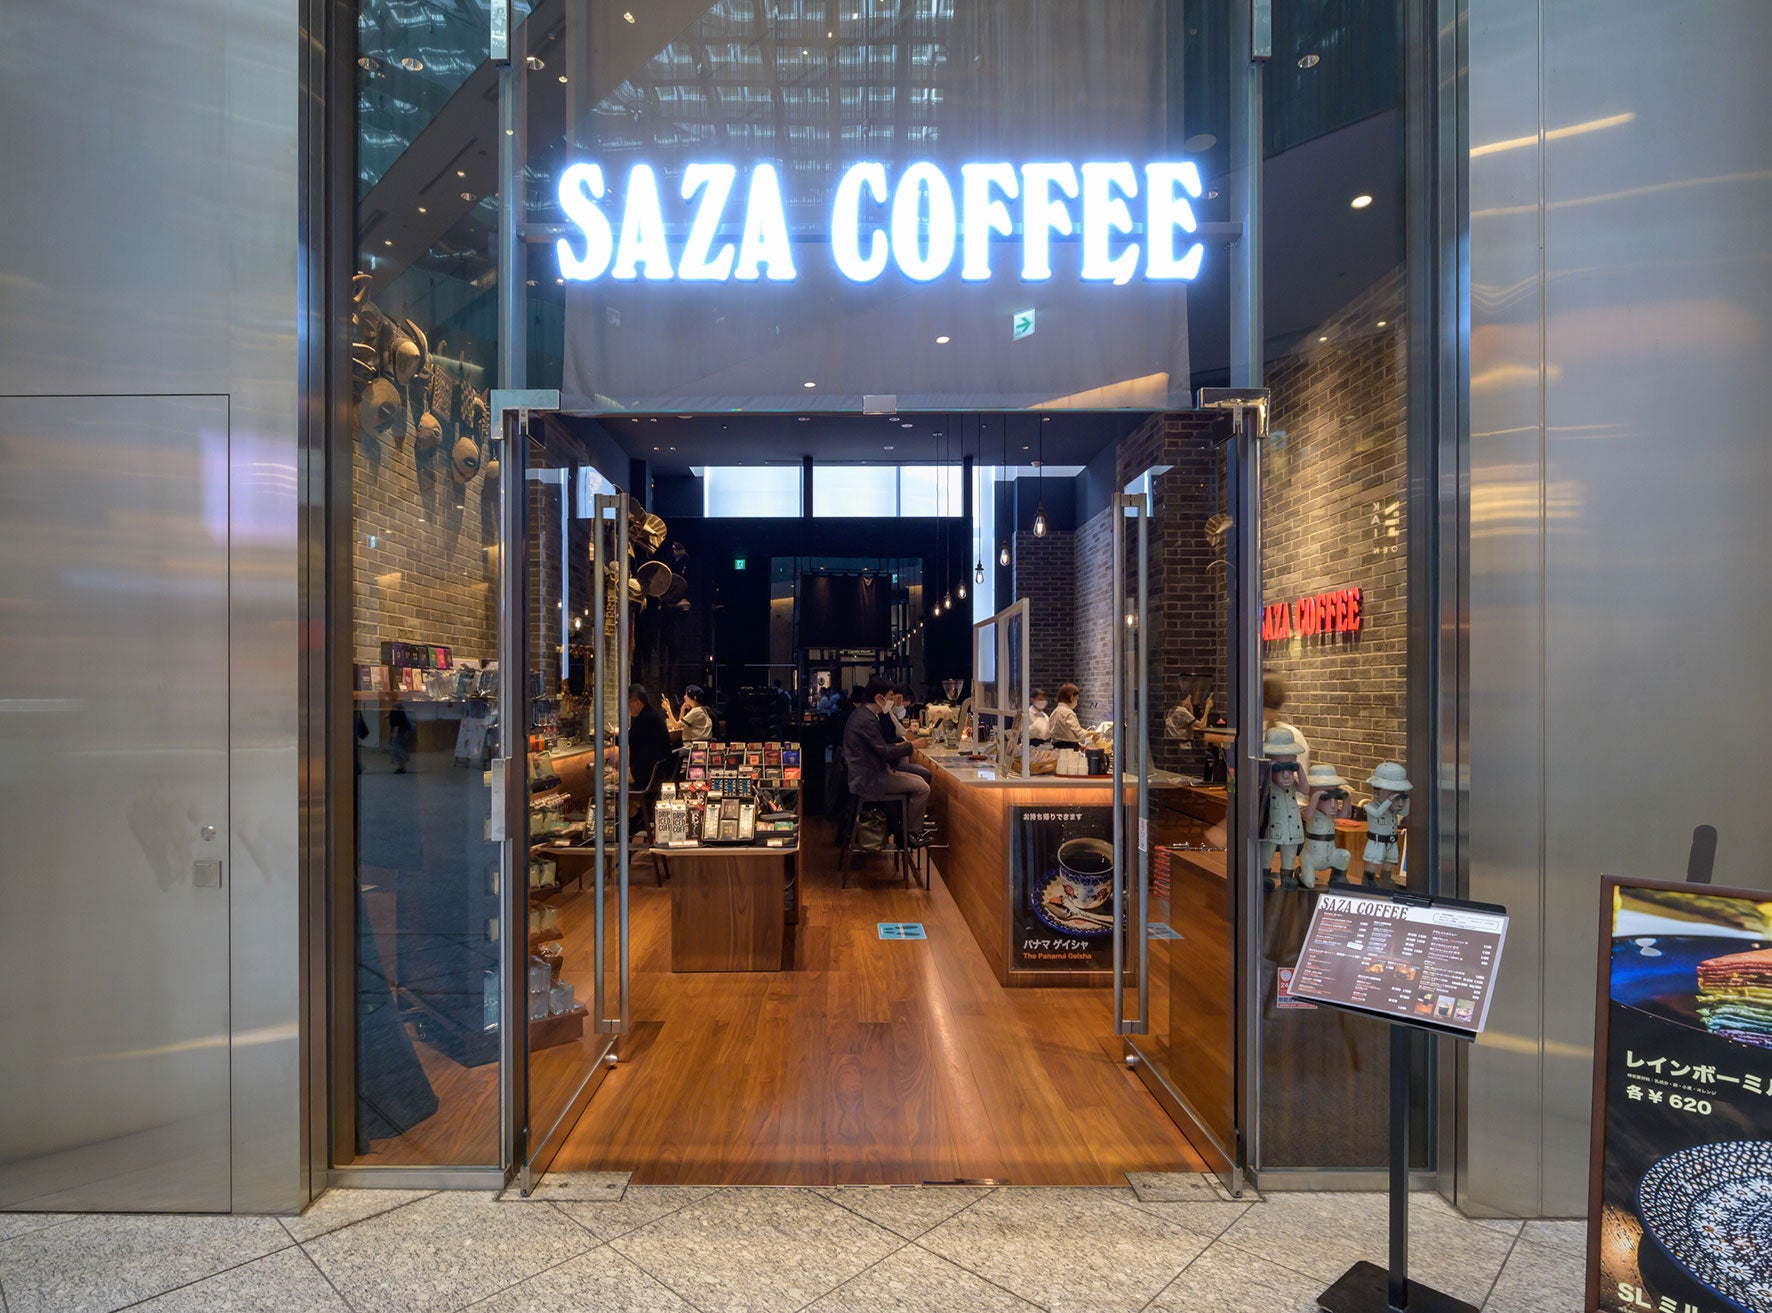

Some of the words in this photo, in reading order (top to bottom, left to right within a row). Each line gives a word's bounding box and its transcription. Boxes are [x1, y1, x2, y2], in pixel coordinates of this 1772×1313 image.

[556, 162, 797, 283] SAZA
[831, 161, 1205, 284] COFFEE
[1262, 602, 1290, 641] AZA
[1294, 587, 1360, 638] COFFEE
[1023, 813, 1083, 821] お持ち帰りできます
[1321, 897, 1352, 914] SAZA
[1356, 901, 1409, 920] COFFEE
